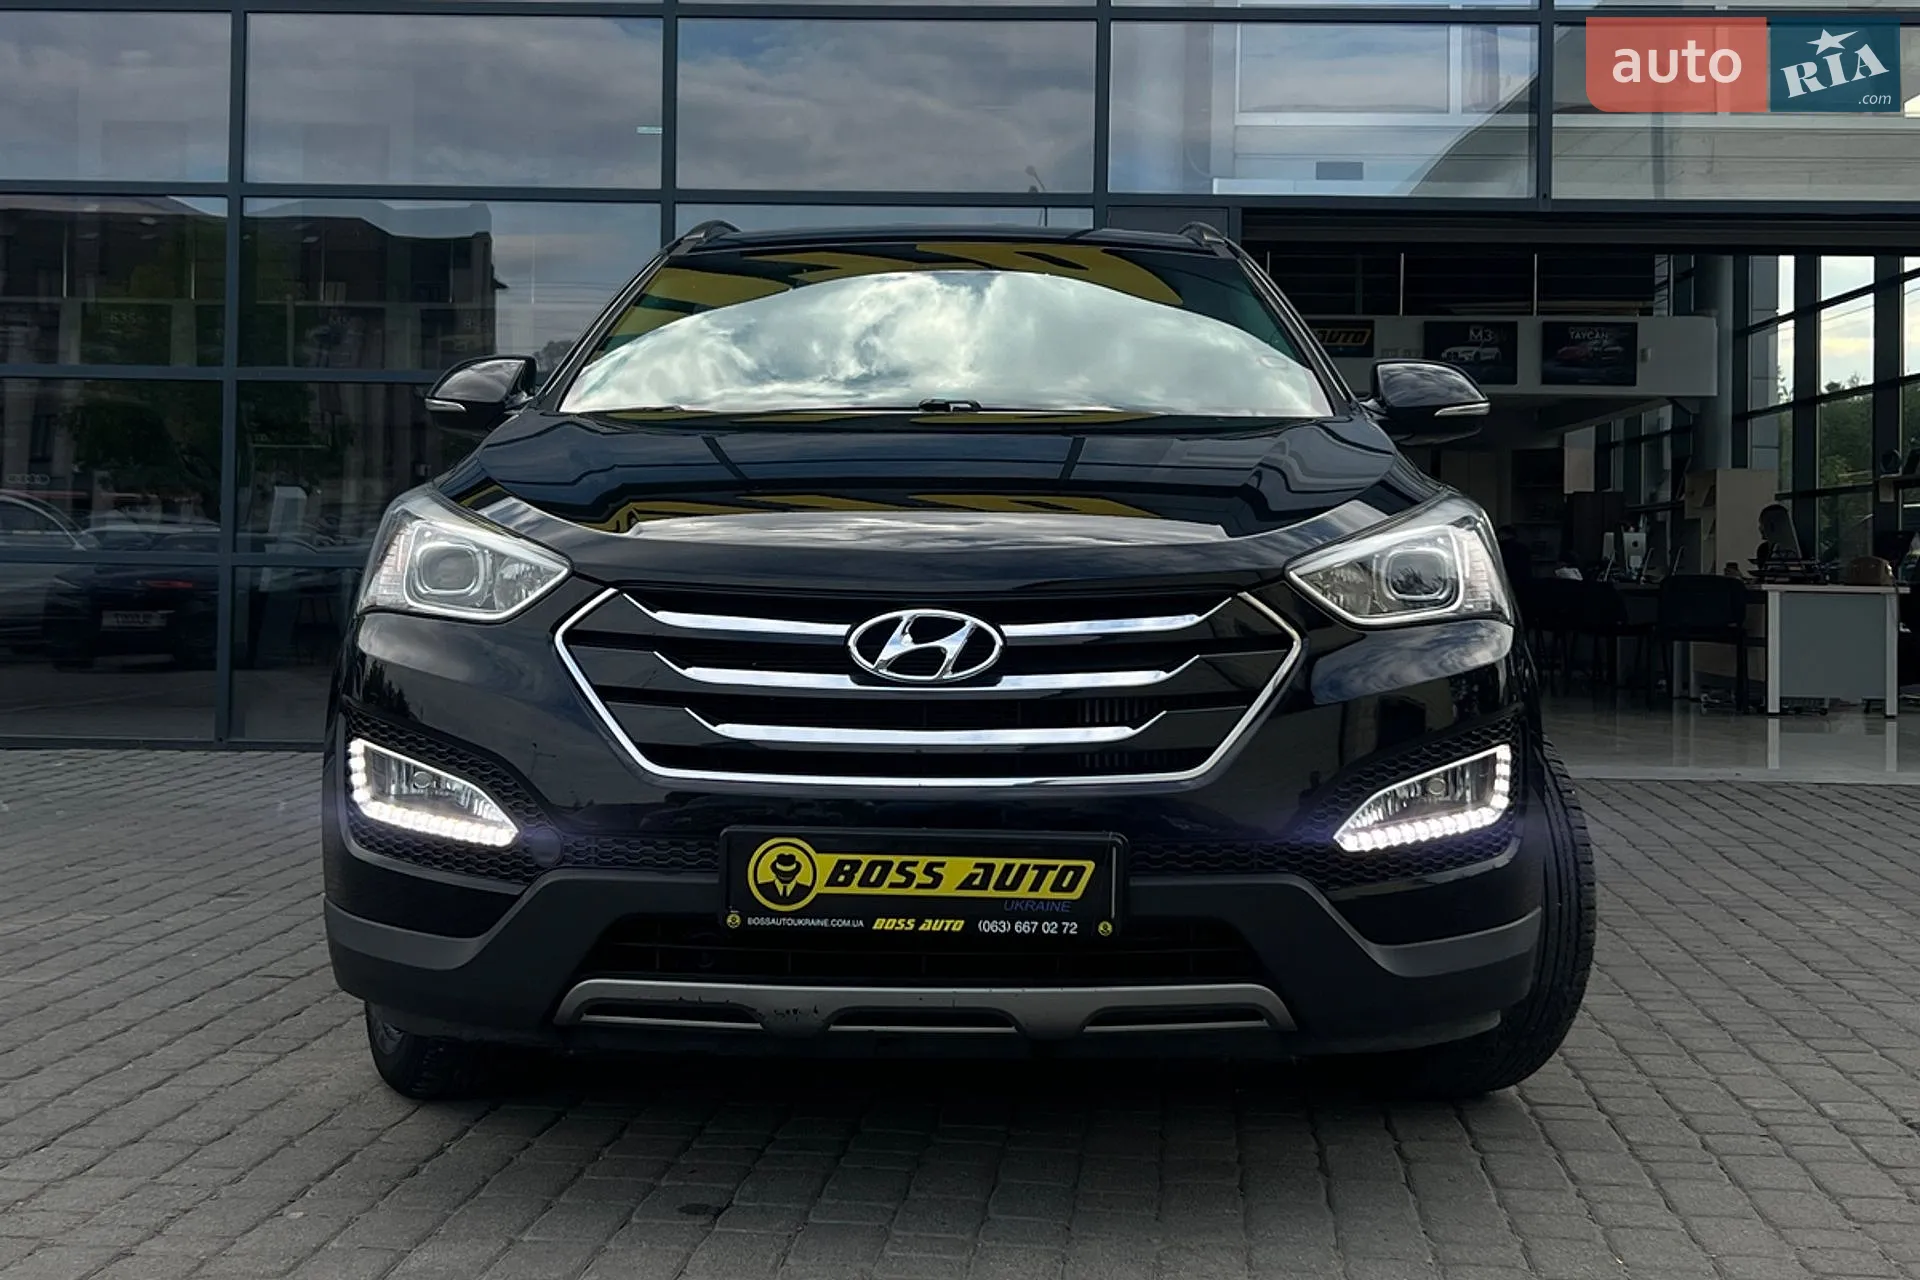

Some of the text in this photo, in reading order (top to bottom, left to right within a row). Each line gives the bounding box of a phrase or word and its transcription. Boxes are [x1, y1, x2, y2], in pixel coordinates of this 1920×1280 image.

[824, 859, 1087, 893] BOSS AUTO
[1003, 899, 1073, 912] UKRAINE
[746, 916, 864, 928] BOSSAUTOUKRAINE.COM.UA
[872, 918, 964, 932] BOSS AUTO
[977, 920, 1078, 935] (063) 667 02 72
